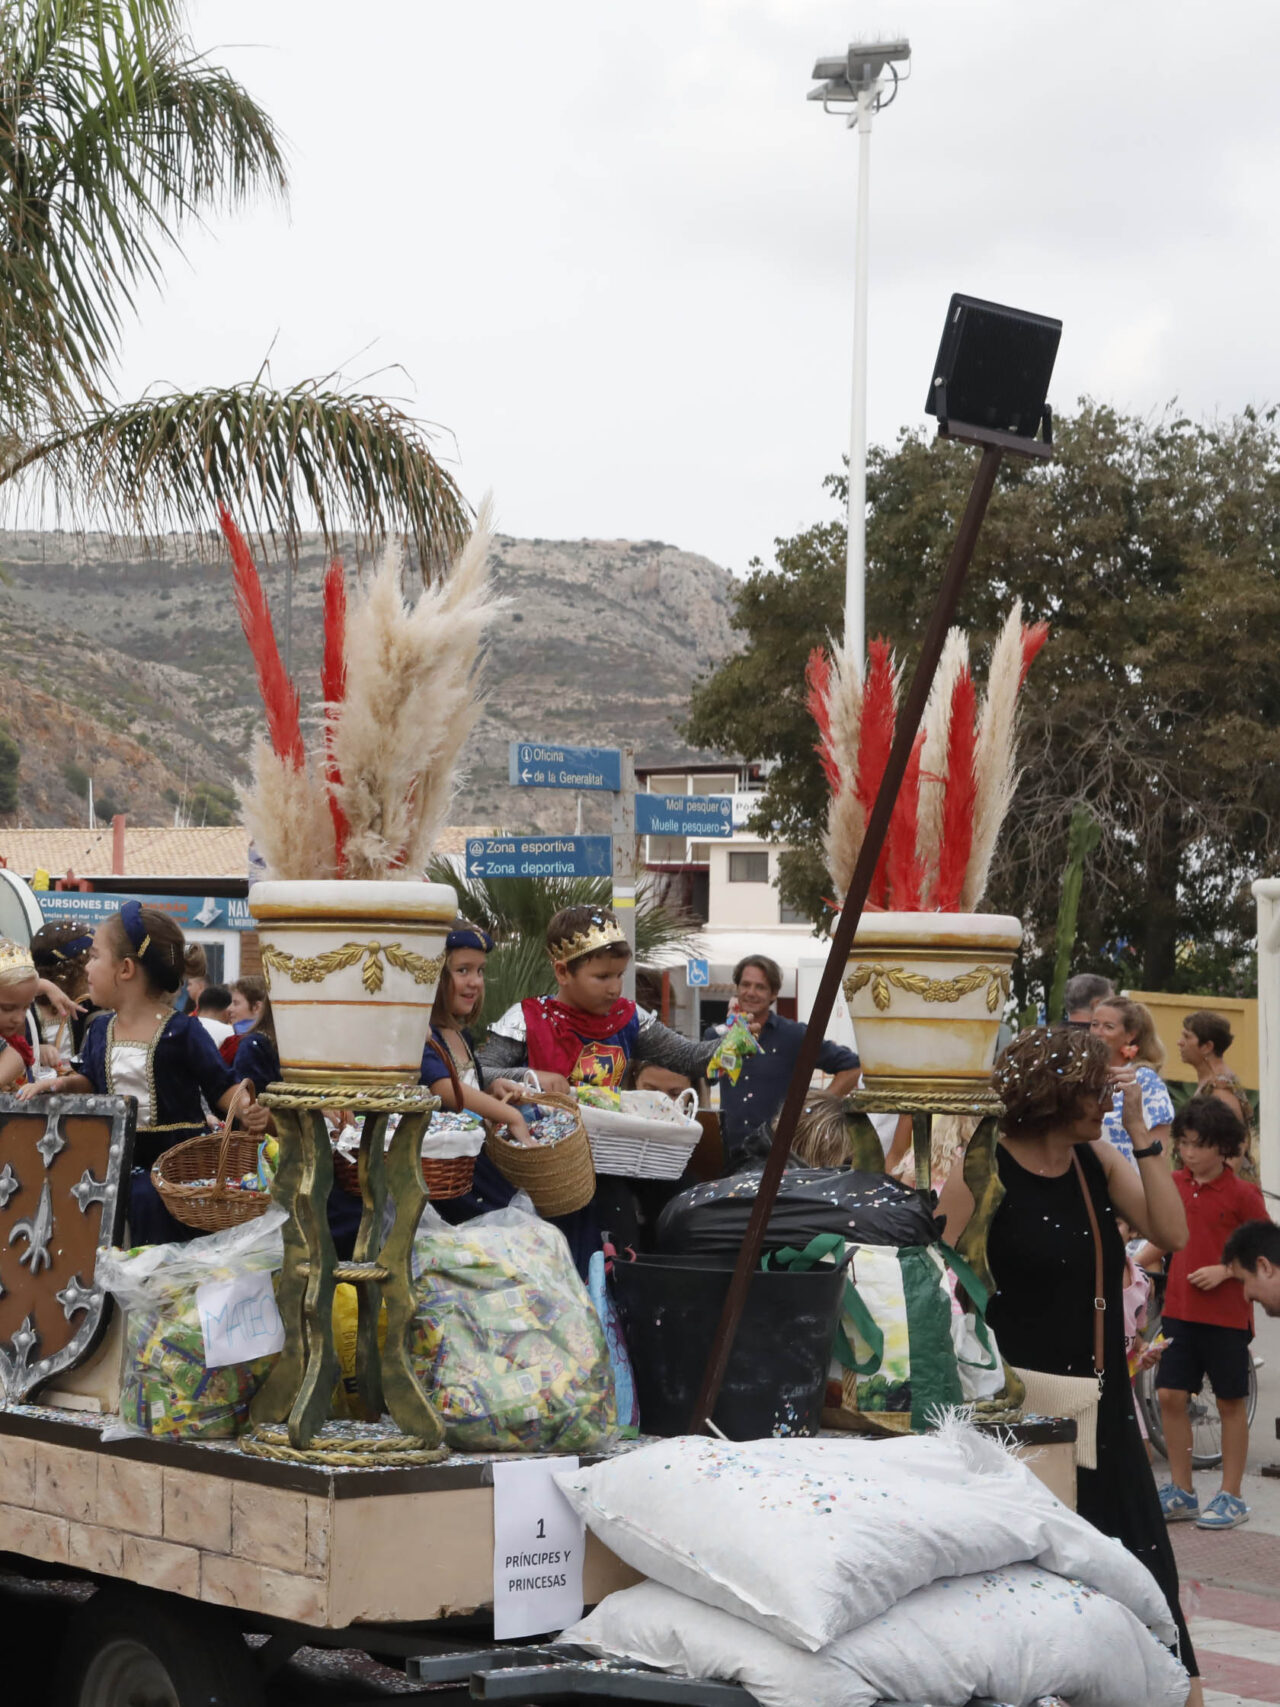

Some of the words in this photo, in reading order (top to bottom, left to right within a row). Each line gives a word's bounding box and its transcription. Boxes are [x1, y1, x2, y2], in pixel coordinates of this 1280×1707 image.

[533, 748, 564, 762] Oficina
[534, 771, 545, 783] de
[549, 771, 556, 783] la
[559, 771, 604, 786] Generalitat
[686, 801, 719, 815] pesquer
[651, 818, 679, 832] Muelle
[682, 821, 720, 835] pesquero
[486, 841, 516, 854] Zona
[521, 839, 575, 856] esportiva
[486, 861, 516, 875] Zona
[521, 860, 575, 876] deportiva
[37, 897, 102, 910] CURSIONES
[104, 899, 119, 910] EN
[205, 1294, 279, 1351] MATEO
[535, 1517, 547, 1539] 1
[505, 1551, 561, 1569] PRÍNCIPES
[564, 1550, 572, 1563] Y
[508, 1573, 567, 1592] PRINCESAS
